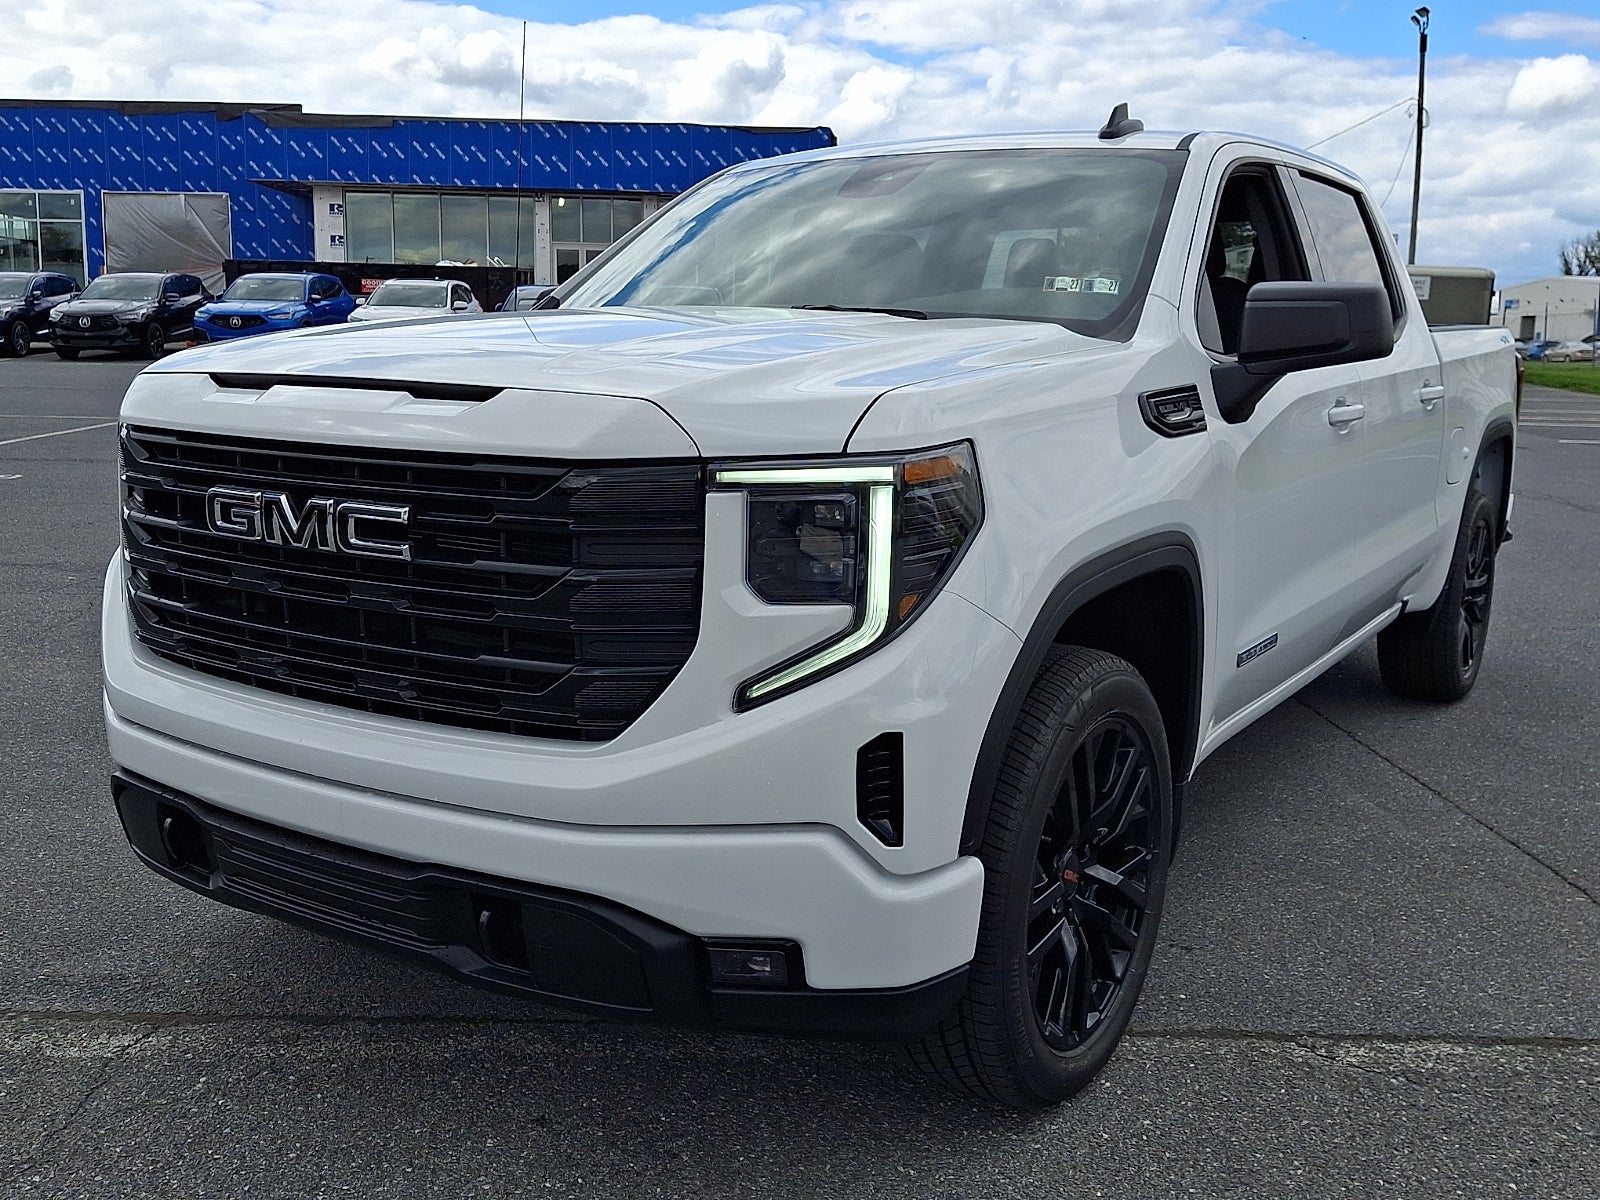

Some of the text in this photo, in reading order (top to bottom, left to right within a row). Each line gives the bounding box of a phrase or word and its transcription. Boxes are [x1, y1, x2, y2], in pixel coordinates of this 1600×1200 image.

[1070, 279, 1079, 290] 27
[1108, 280, 1118, 292] 27
[205, 485, 412, 562] GMC
